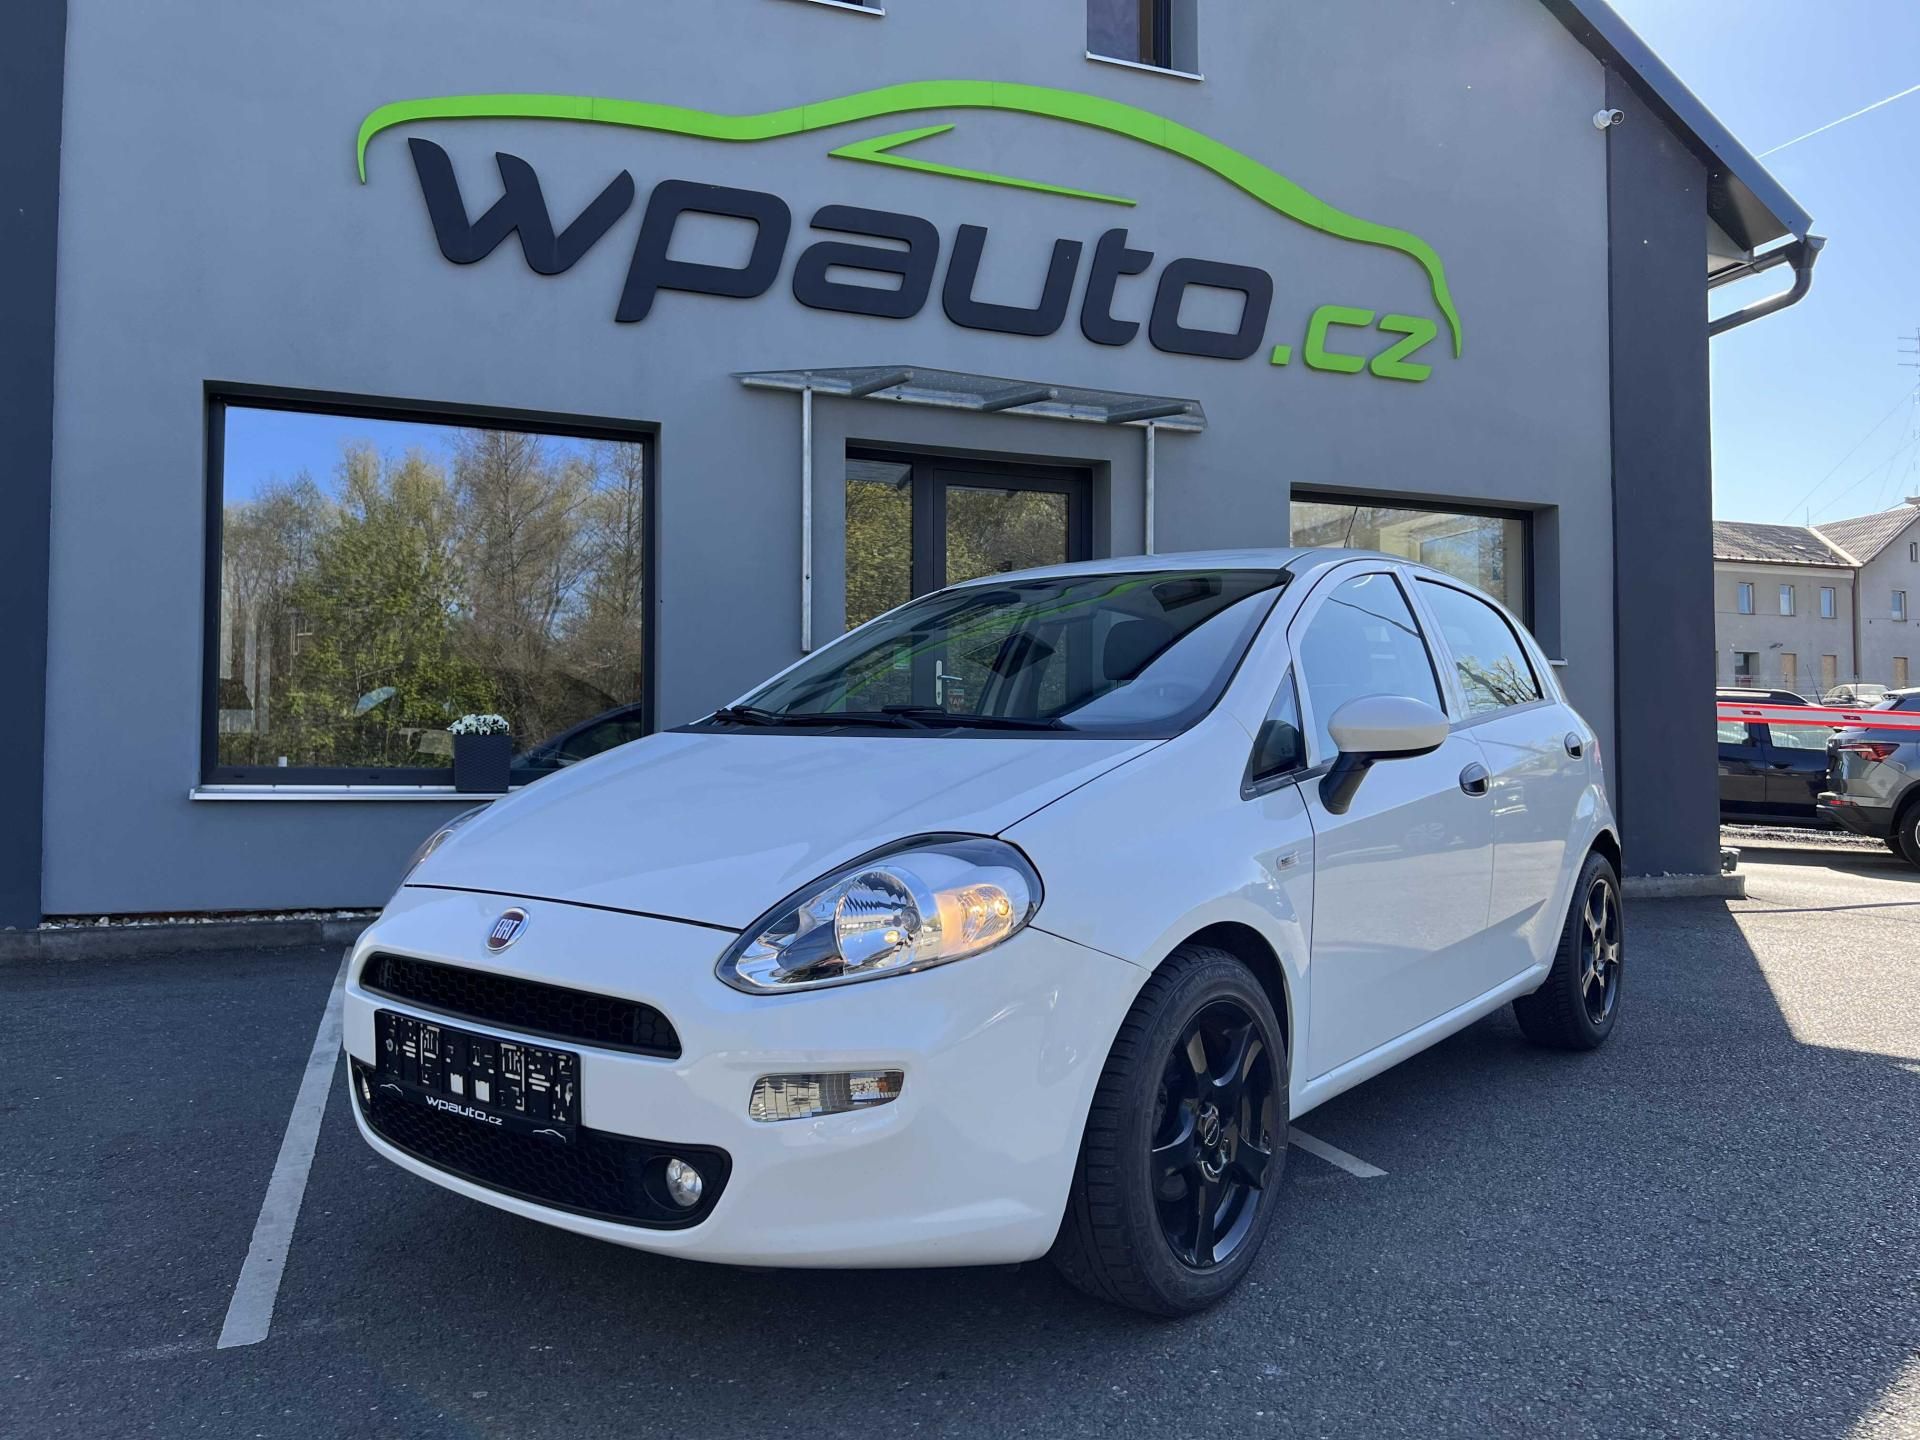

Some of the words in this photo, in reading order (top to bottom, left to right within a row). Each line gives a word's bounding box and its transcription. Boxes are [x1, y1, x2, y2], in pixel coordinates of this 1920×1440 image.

[408, 137, 1436, 382] wpauto.cz
[491, 918, 520, 940] FIAT
[425, 1095, 503, 1126] wpauto.cz
